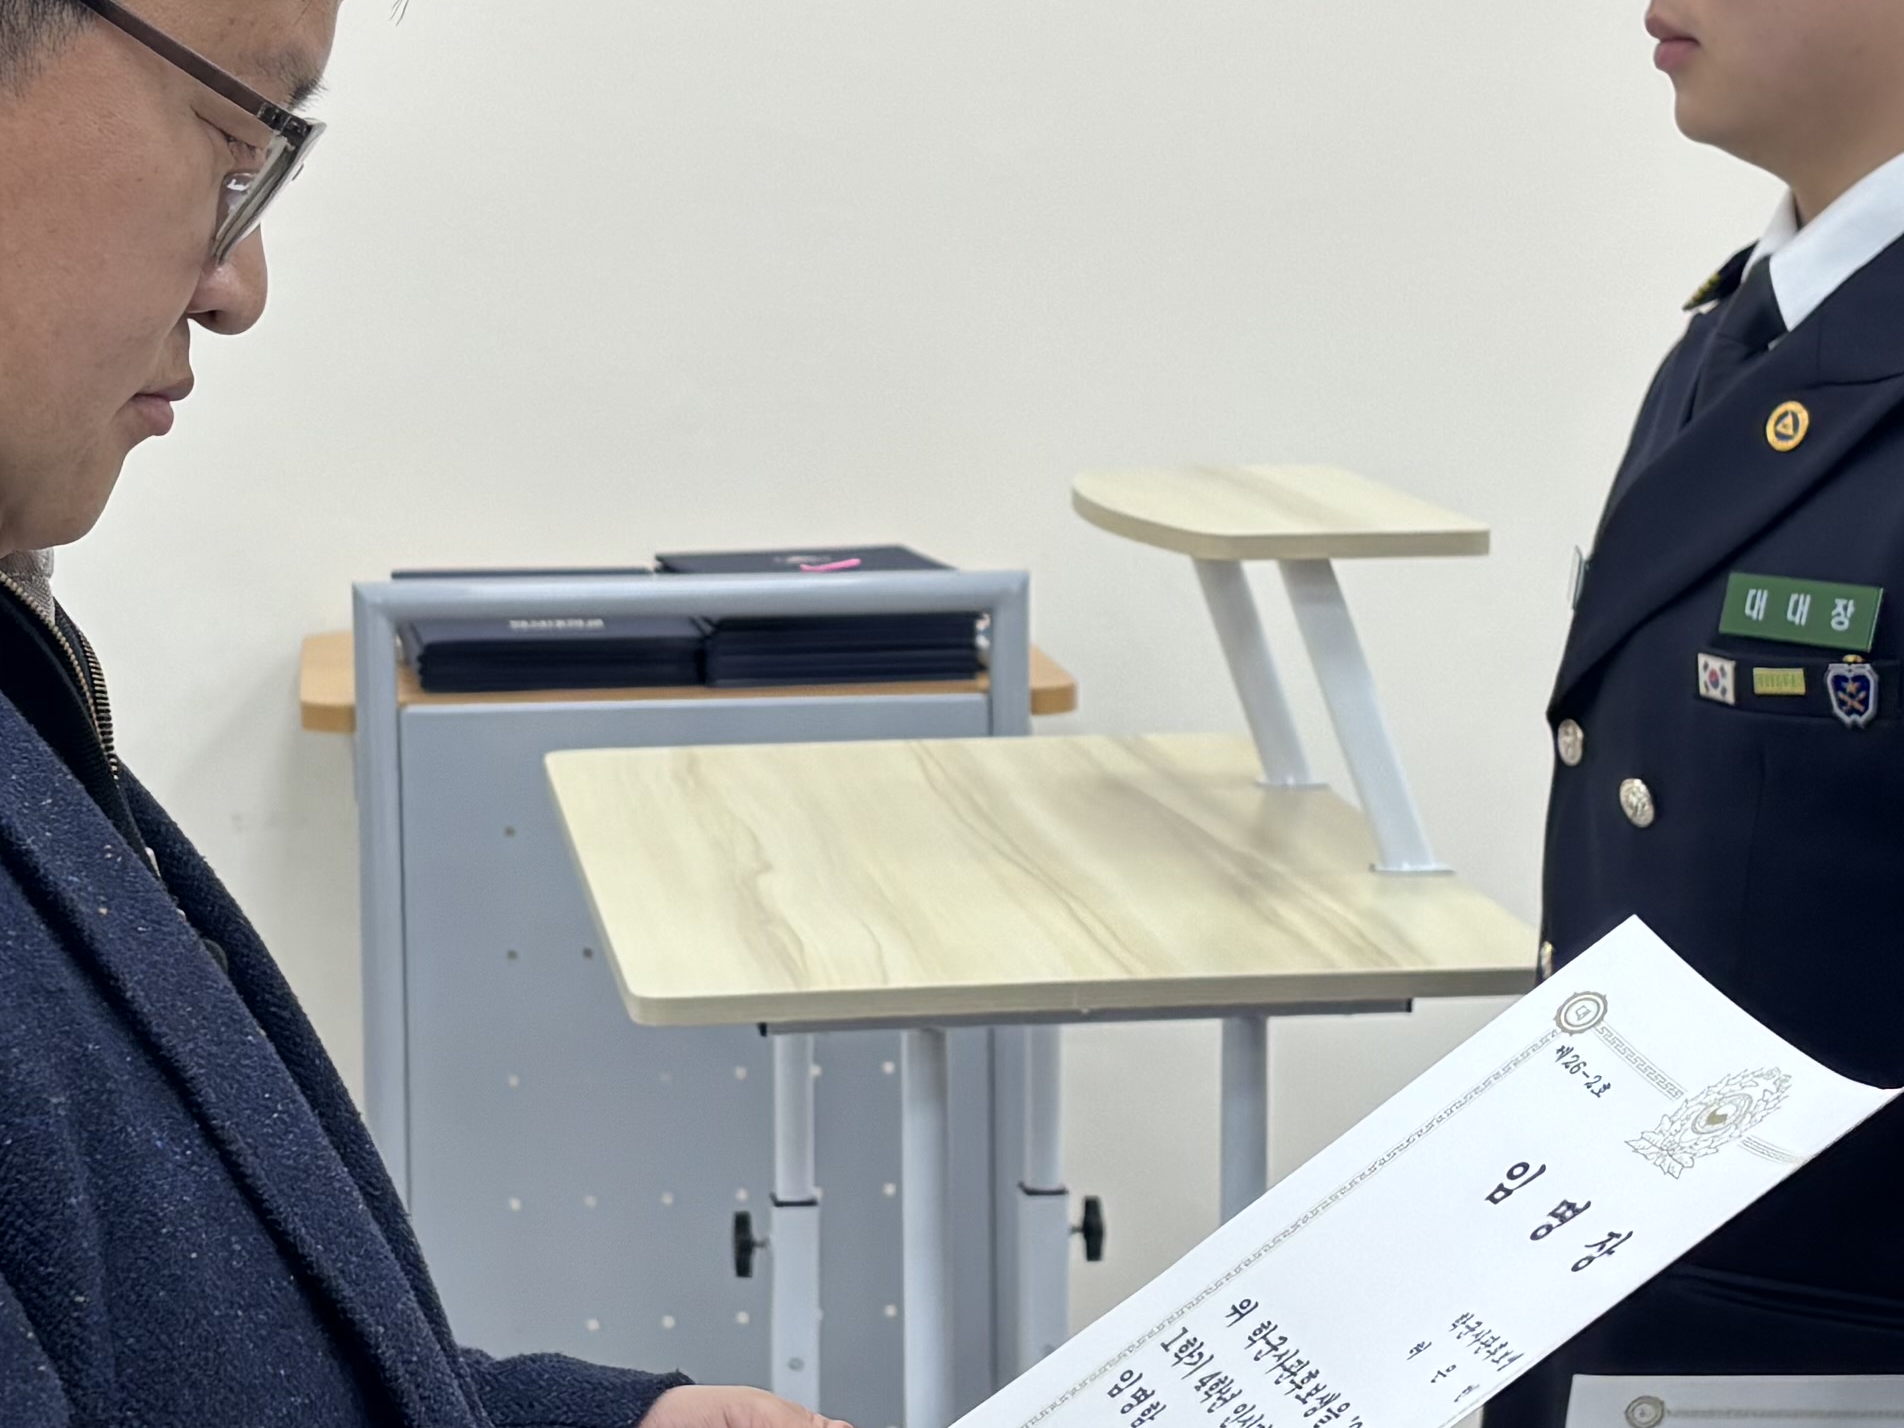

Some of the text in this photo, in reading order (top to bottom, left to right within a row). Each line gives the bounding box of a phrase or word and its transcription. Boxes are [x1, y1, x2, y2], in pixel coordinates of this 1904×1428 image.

[1744, 588, 1856, 632] 대대장
[1555, 1044, 1611, 1098] 제26-2호
[1160, 1326, 1214, 1380] 1학기
[1194, 1371, 1242, 1414] 4학년
[1224, 1298, 1259, 1328] 위
[1244, 1320, 1351, 1428] 학군사관후보생을
